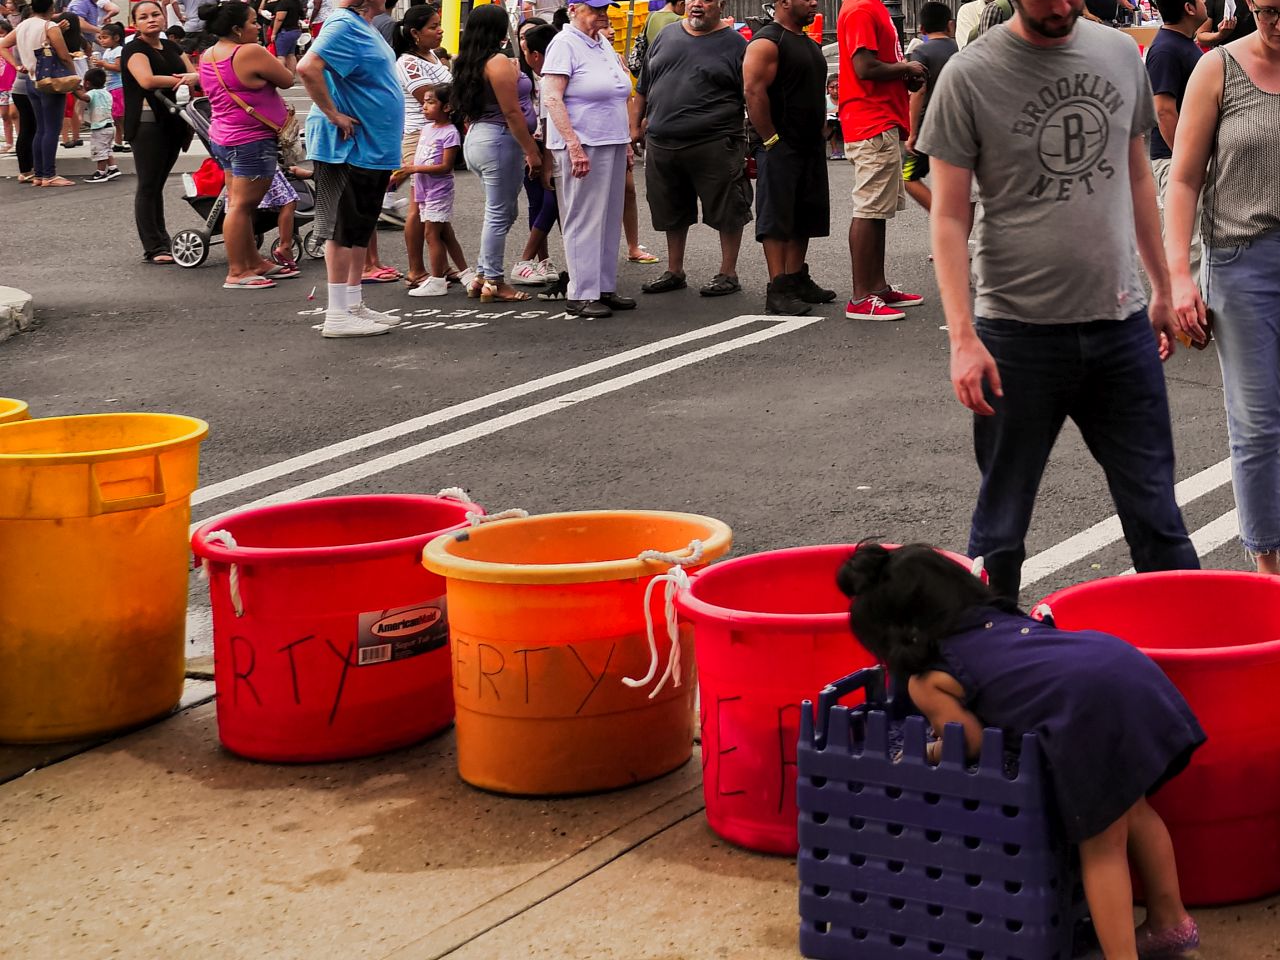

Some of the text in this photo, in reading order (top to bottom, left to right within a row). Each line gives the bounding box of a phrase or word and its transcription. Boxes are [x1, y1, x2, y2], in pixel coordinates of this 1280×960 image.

[1010, 72, 1125, 137] BROOKLYN
[1062, 113, 1085, 165] B
[1027, 158, 1116, 201] NETS
[206, 199, 223, 229] BRAVO
[377, 610, 437, 633] AmericanMaid
[456, 638, 616, 714] ERTY
